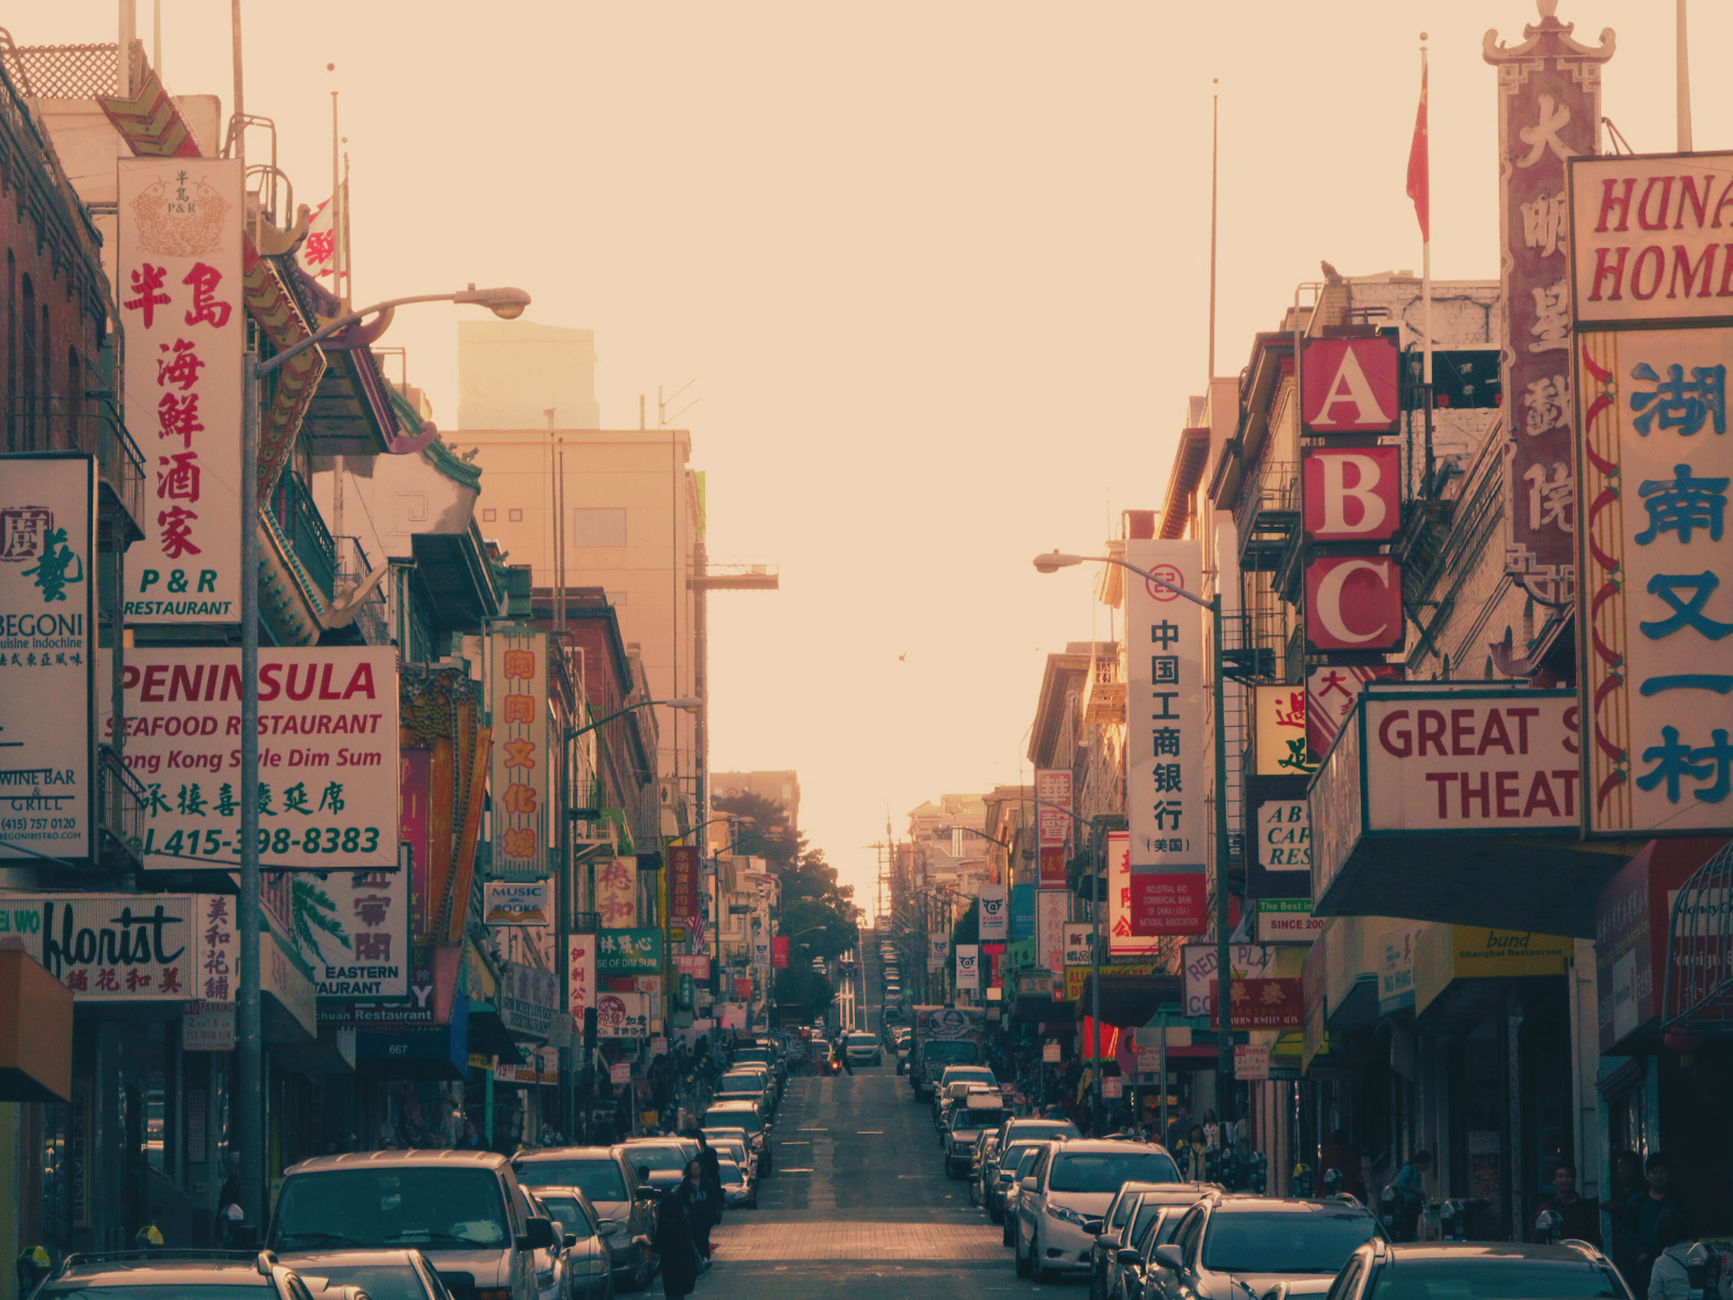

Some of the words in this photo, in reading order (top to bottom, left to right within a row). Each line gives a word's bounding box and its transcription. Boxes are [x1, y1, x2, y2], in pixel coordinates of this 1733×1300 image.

[123, 262, 232, 330] 半島
[157, 338, 206, 559] 海鮮酒家
[140, 569, 160, 593] P
[167, 569, 189, 593] &
[197, 570, 218, 593] R
[124, 601, 232, 615] RESTAURANT
[33, 638, 82, 648] indochine
[122, 662, 376, 702] PENINSULA
[225, 714, 382, 735] RSTAURANT
[1151, 619, 1183, 830] 中国工商银行
[1379, 708, 1540, 758] GREAT
[123, 755, 160, 774] ong
[167, 751, 223, 772] Kong
[287, 748, 330, 767] Dim
[336, 749, 381, 767] Sum
[44, 770, 76, 785] BAR
[11, 799, 63, 812] GRILL
[1, 818, 27, 831] (415)
[30, 818, 48, 830] 757
[51, 818, 76, 830] 0120
[492, 887, 541, 897] MUSIC
[1261, 902, 1276, 911] The
[1280, 902, 1300, 911] Best
[1271, 919, 1302, 930] SINCE
[43, 902, 185, 979] florist
[1507, 948, 1563, 957] Restaurant
[608, 958, 620, 968] OF
[621, 958, 637, 968] DIM
[638, 957, 657, 967] SUM
[325, 966, 399, 980] EASTERN
[200, 1002, 234, 1014] PARKING
[355, 1010, 432, 1021] Restaurant
[188, 1018, 195, 1028] 2
[389, 1045, 407, 1054] 667
